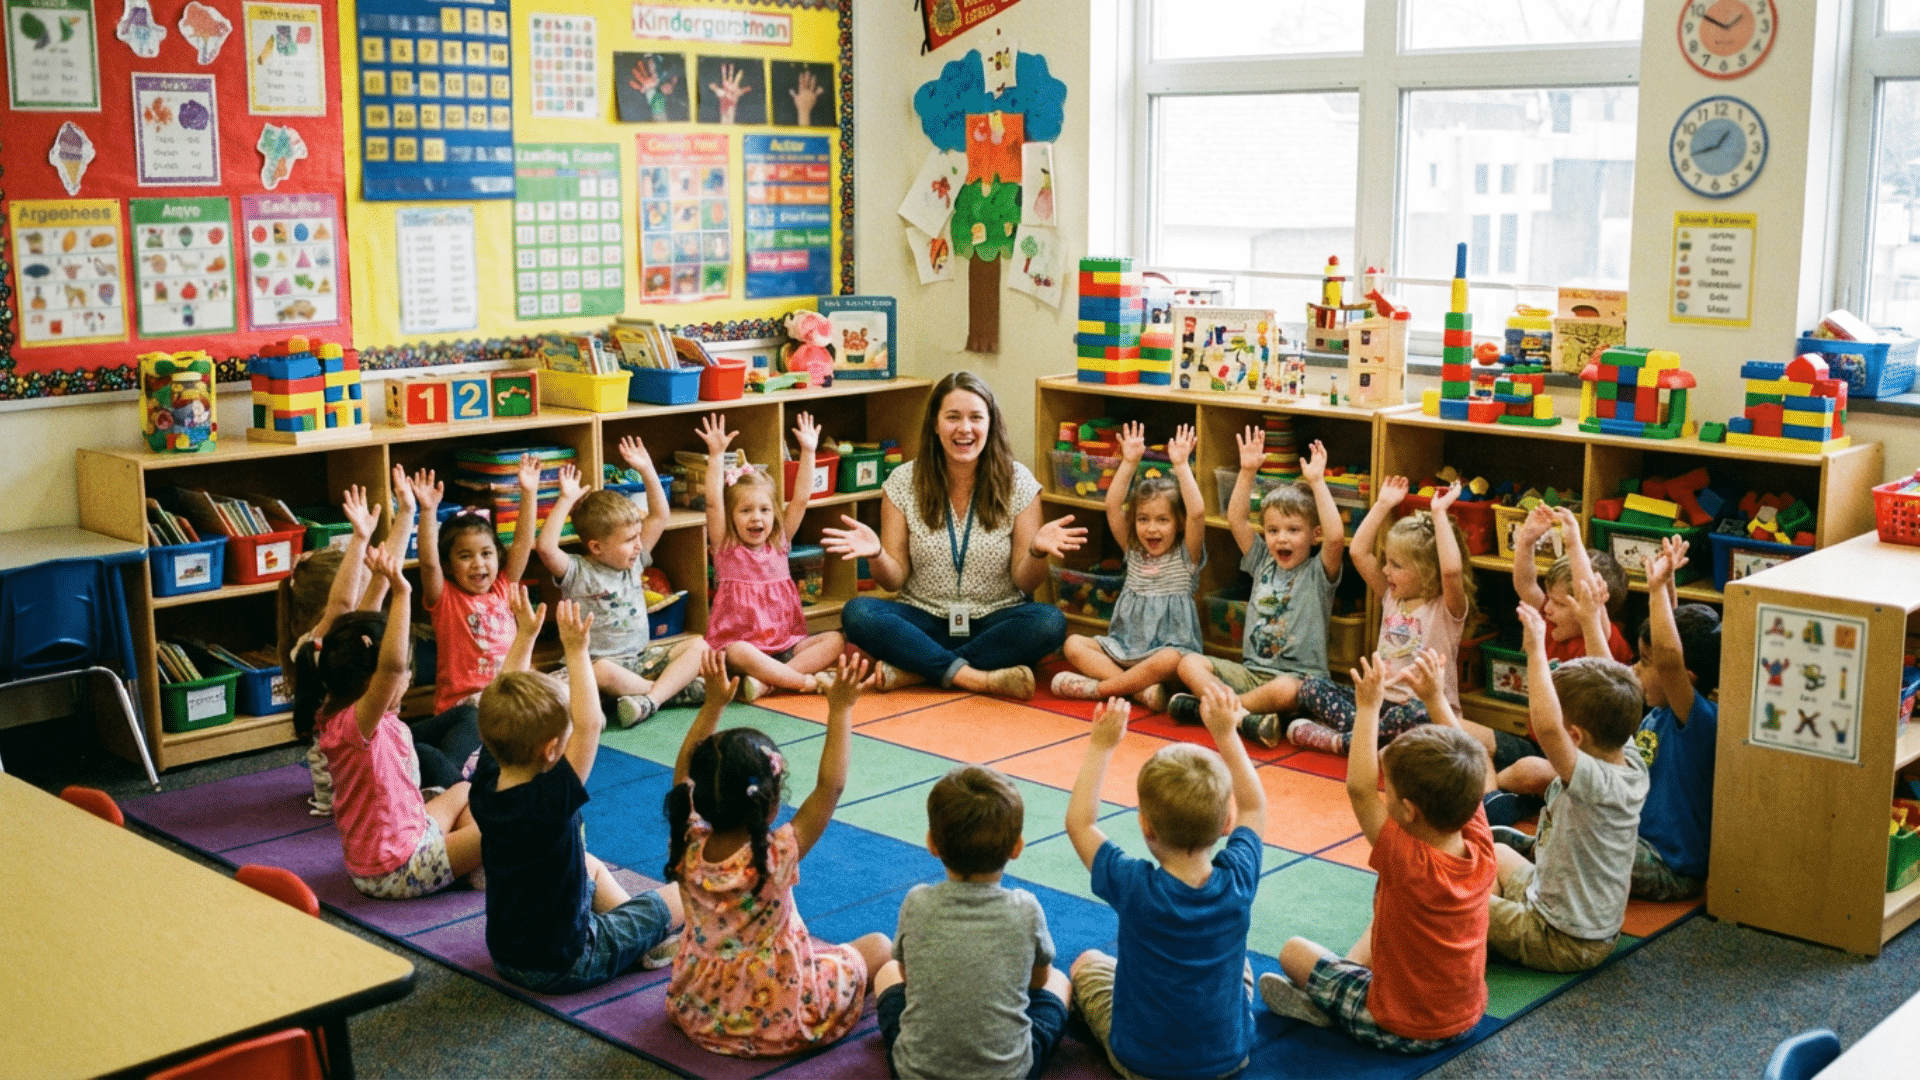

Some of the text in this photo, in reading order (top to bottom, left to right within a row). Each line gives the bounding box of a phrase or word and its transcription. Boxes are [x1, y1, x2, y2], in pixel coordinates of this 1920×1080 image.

[1691, 4, 1705, 17] 10
[1757, 1, 1766, 14] 2
[1685, 22, 1693, 33] 9
[1760, 19, 1769, 33] 3
[1689, 40, 1698, 53] 8
[1753, 39, 1761, 51] 4
[1702, 54, 1711, 66] 7
[1719, 60, 1728, 72] 6
[1738, 54, 1747, 67] 5
[1697, 109, 1708, 121] 11
[1715, 103, 1728, 116] 12
[1738, 108, 1743, 120] 1
[1683, 122, 1697, 135] 10
[1748, 122, 1757, 135] 2
[1677, 140, 1685, 152] 9
[1751, 140, 1761, 155] 3
[1744, 160, 1753, 172] 4
[1694, 173, 1703, 185] 7
[1711, 179, 1720, 192] 6
[1730, 173, 1740, 187] 5
[418, 382, 483, 420] 1 2
